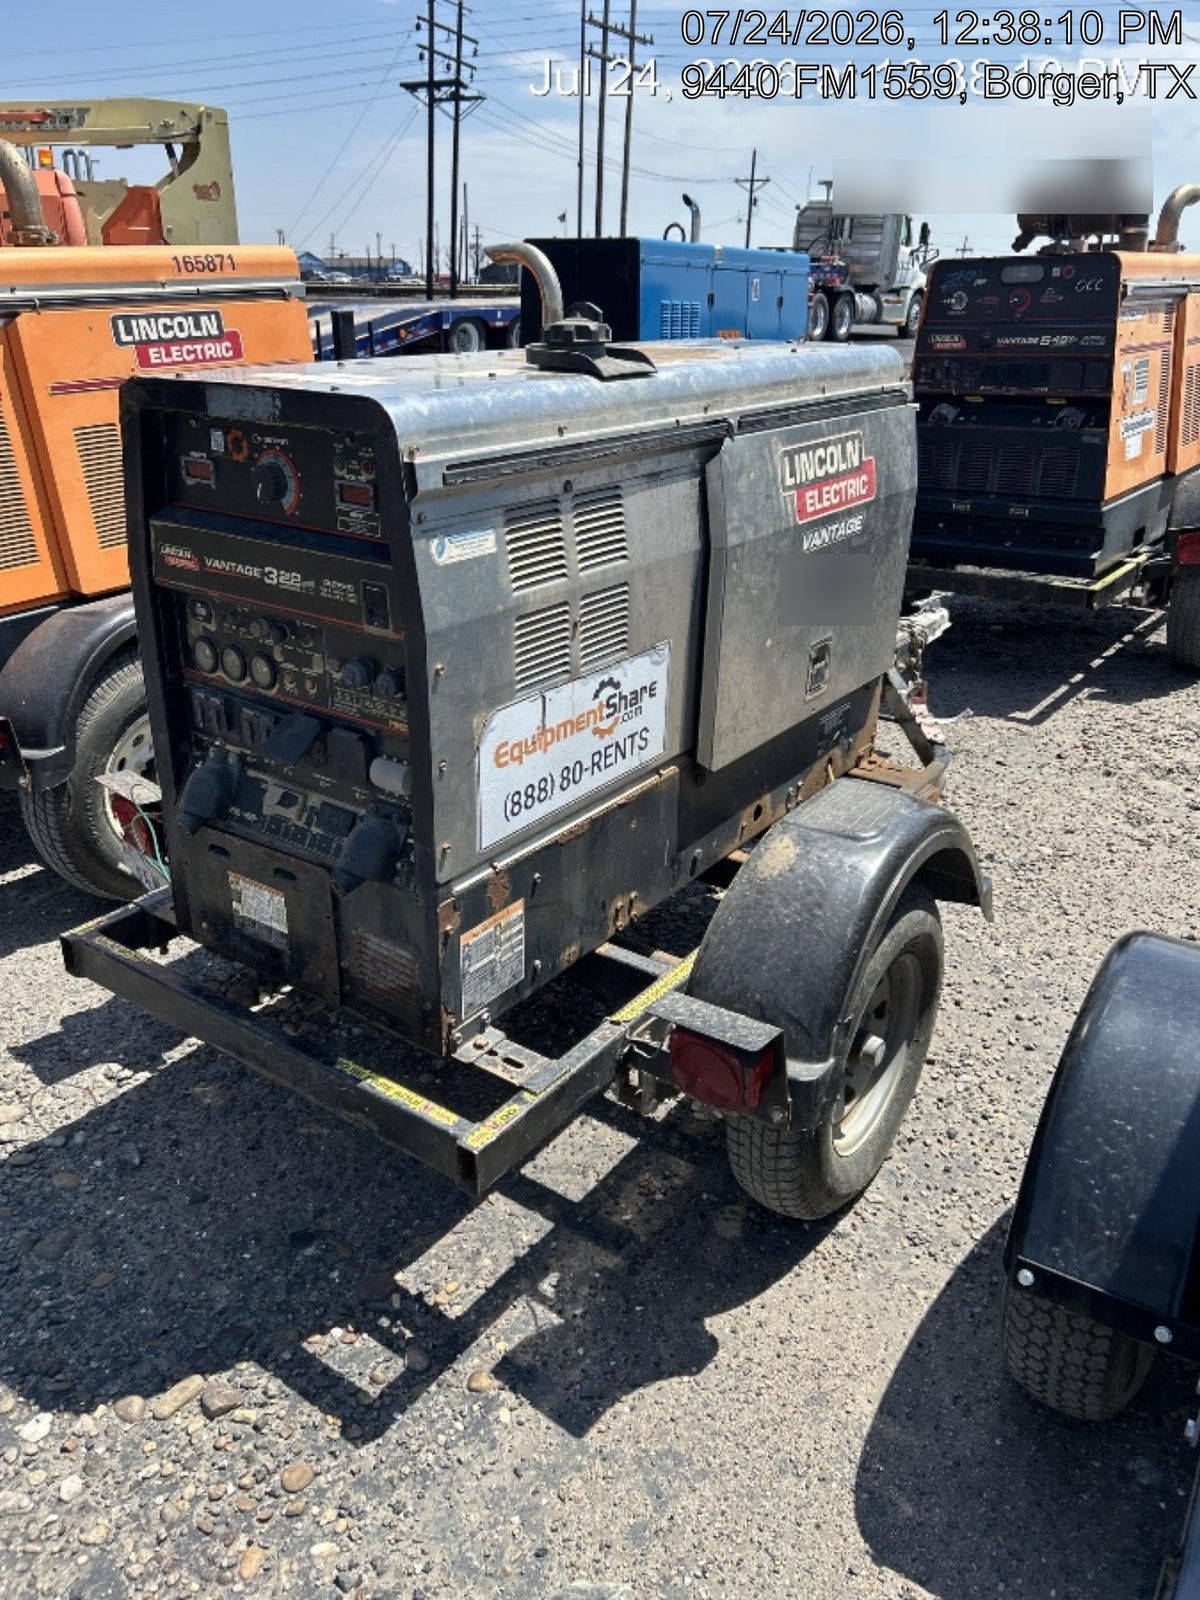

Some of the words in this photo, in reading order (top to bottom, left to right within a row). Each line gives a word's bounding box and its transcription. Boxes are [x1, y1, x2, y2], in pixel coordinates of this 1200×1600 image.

[172, 254, 237, 273] 165871
[116, 314, 219, 342] LINCOLN
[148, 341, 234, 364] ELECTRIC
[783, 438, 860, 487] LINCOLN
[804, 474, 869, 513] ELECTRIC
[801, 514, 865, 553] VANTAGE
[203, 556, 263, 579] VANTAGE
[493, 680, 658, 769] EquipmentShare
[504, 772, 556, 822] (888)
[559, 726, 651, 792] 80-RENTS
